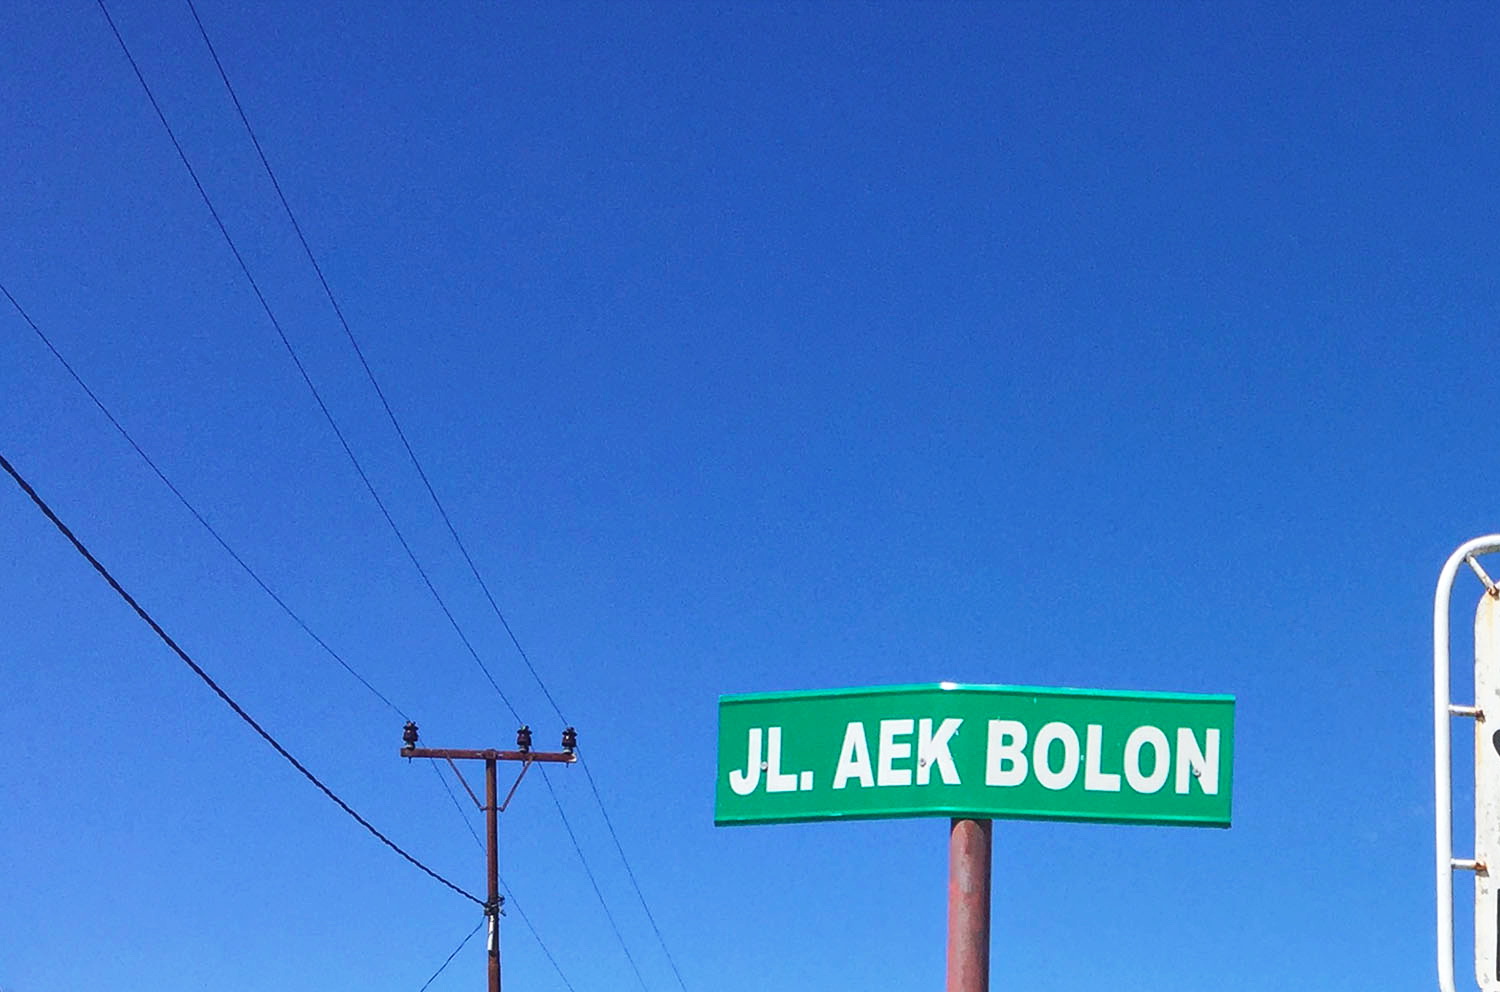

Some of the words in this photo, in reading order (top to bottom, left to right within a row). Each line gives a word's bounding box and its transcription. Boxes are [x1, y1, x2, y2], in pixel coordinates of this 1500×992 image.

[729, 727, 813, 795] JL.
[833, 718, 963, 789] AEK
[985, 719, 1220, 795] BOLON
